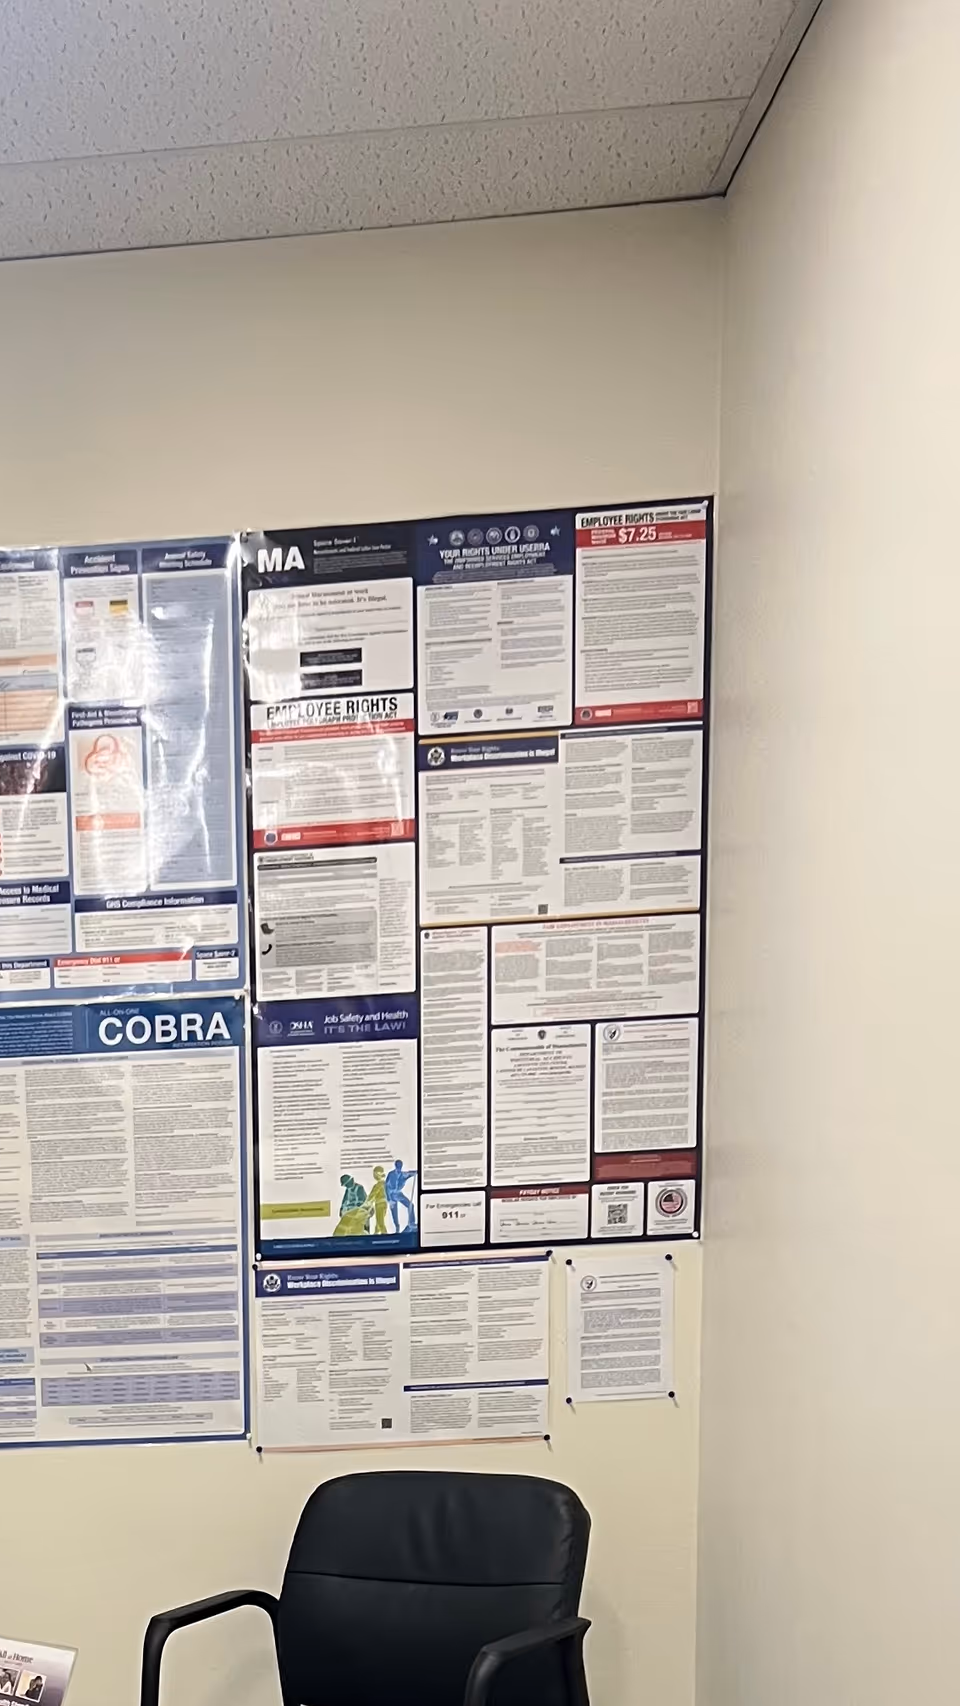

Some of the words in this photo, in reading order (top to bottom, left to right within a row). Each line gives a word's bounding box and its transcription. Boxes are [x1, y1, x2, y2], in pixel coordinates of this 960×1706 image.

[581, 515, 623, 528] EMPLOYEE
[625, 512, 654, 525] RIGHTS
[618, 526, 656, 544] $7.25
[257, 546, 305, 573] MA
[346, 696, 398, 714] RIGHTS
[323, 1015, 339, 1024] Job
[339, 1013, 364, 1024] Safety
[364, 1011, 380, 1021] and
[381, 1009, 408, 1021] Health
[98, 1012, 231, 1046] COBRA
[347, 1023, 371, 1033] THE
[374, 1021, 406, 1032] LAW!
[441, 1210, 459, 1219] 911
[12, 1652, 34, 1664] Home
